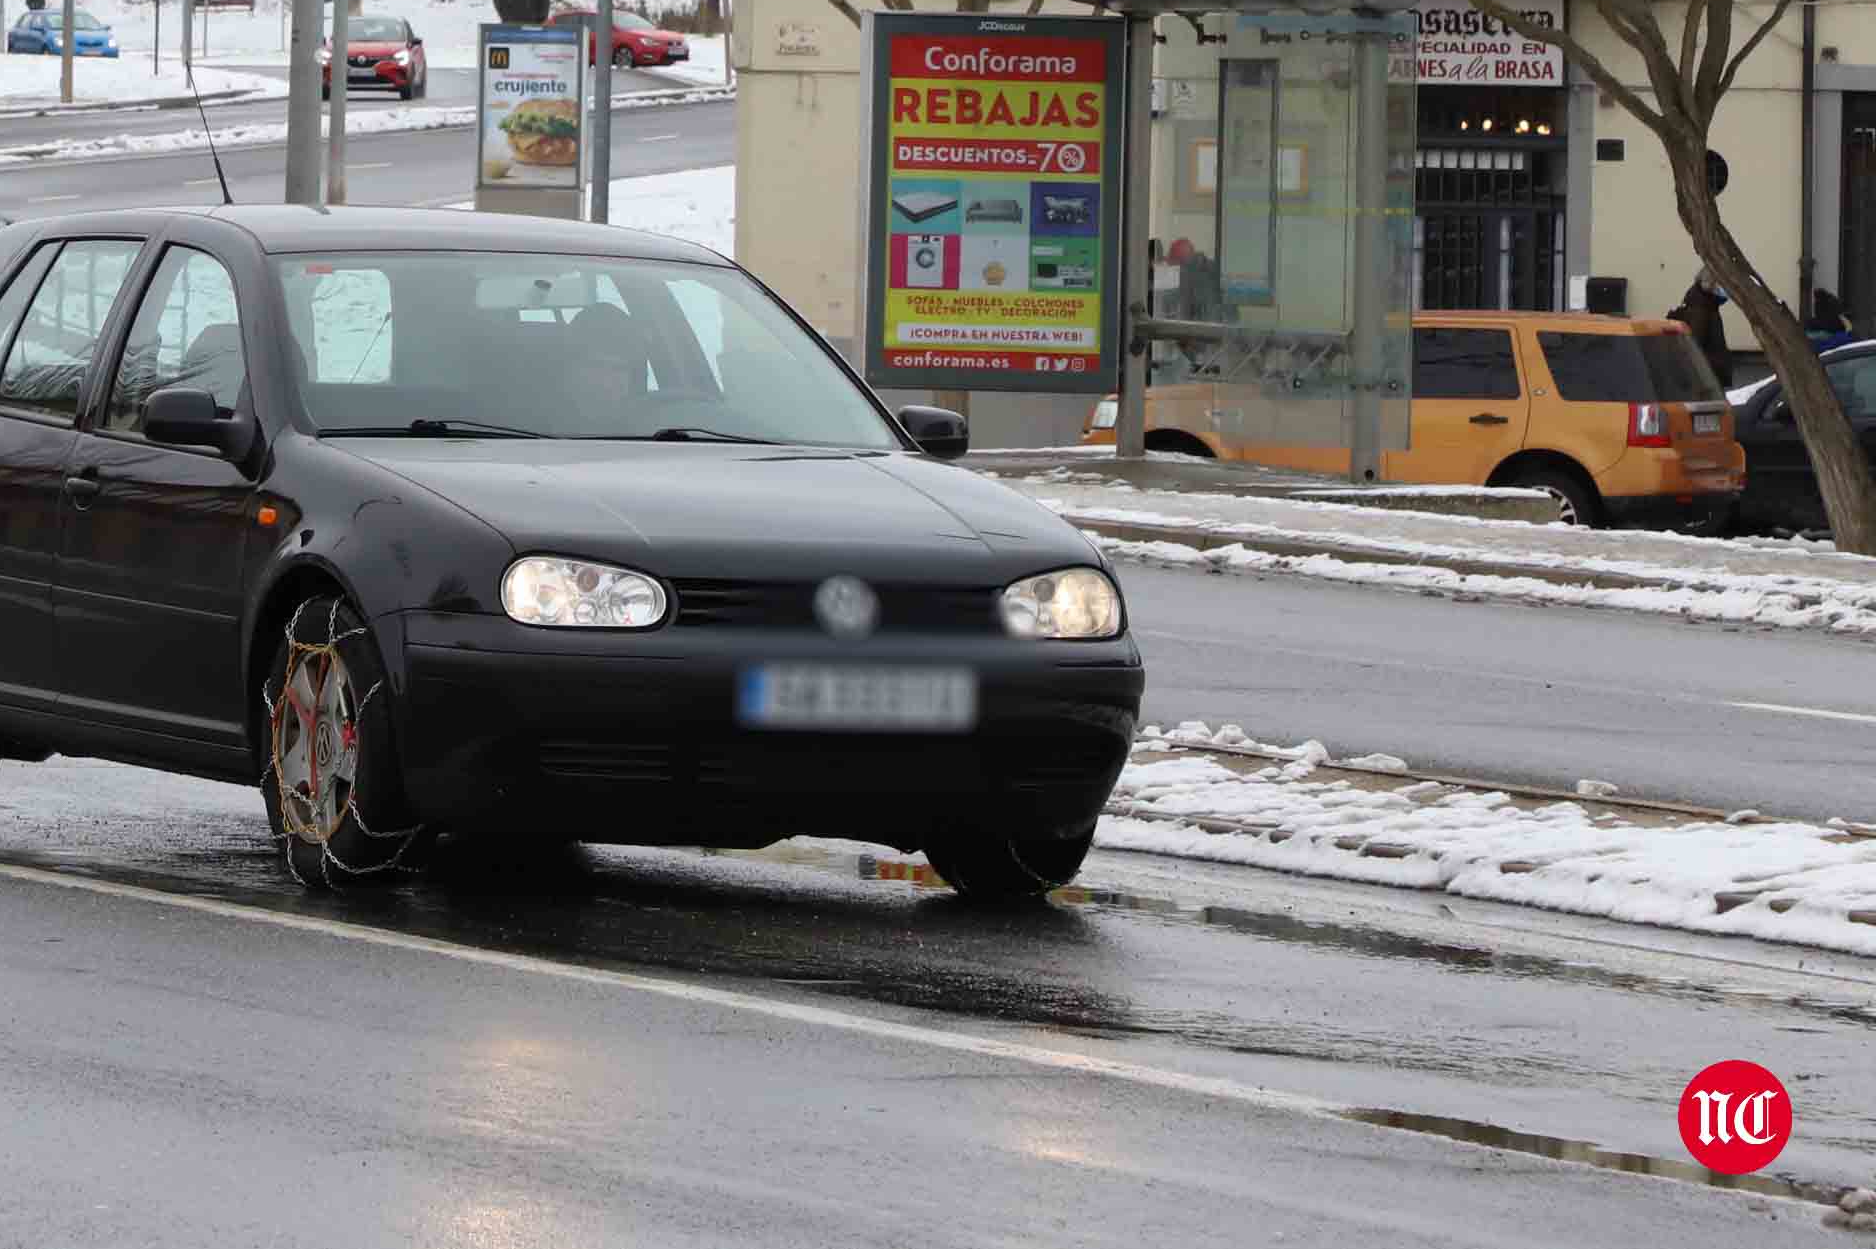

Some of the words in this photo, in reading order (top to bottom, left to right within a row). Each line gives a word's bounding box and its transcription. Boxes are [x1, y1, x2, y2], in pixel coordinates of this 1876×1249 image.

[1522, 42, 1547, 55] EN
[924, 46, 1077, 75] Conforama
[1494, 60, 1555, 80] BRASA
[494, 79, 568, 96] crujiente
[893, 87, 1100, 128] REBAJAS
[898, 144, 1028, 165] DESCUENTOS
[1015, 298, 1084, 309] COLCHONES
[971, 330, 988, 340] EN
[992, 330, 1047, 341] NUESTRA
[893, 352, 1010, 369] conforama.es
